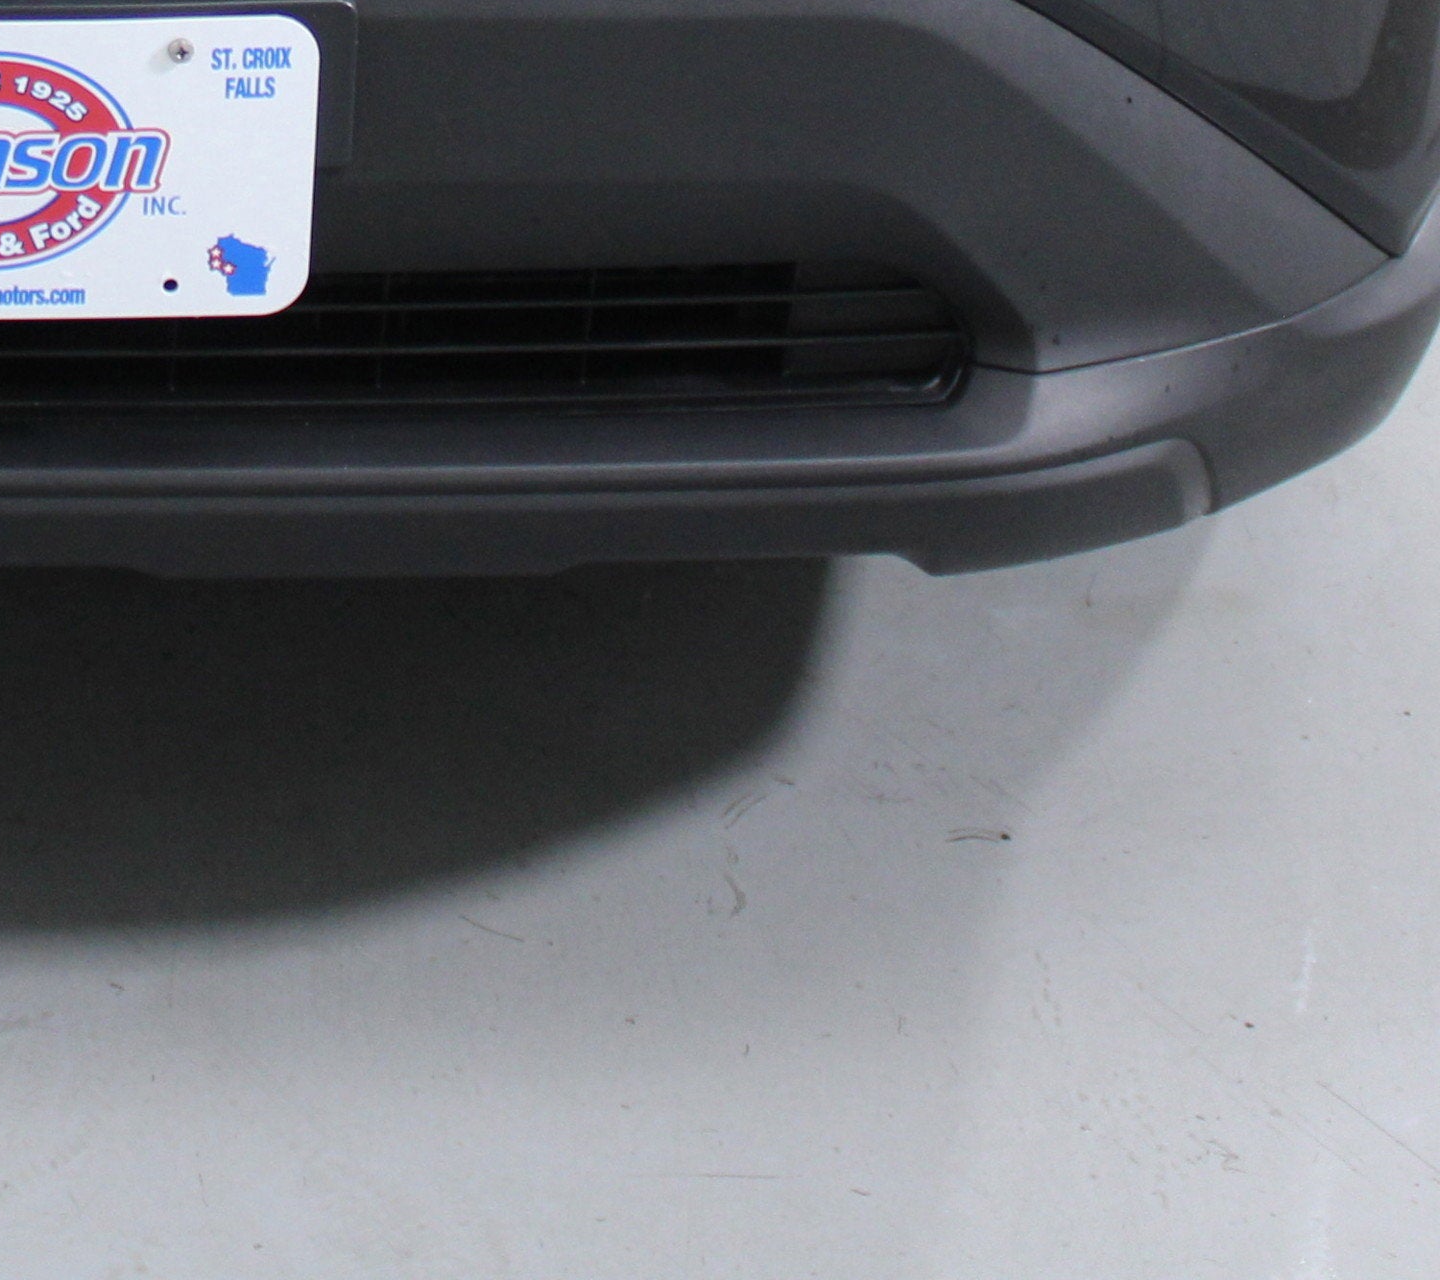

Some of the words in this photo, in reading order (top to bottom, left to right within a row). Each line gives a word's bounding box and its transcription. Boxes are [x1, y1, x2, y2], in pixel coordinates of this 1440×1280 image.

[210, 47, 237, 70] ST.
[242, 46, 292, 70] CROIX
[14, 75, 89, 122] 1925
[225, 76, 275, 99] FALLS
[141, 196, 187, 216] INC.
[28, 194, 102, 250] Ford
